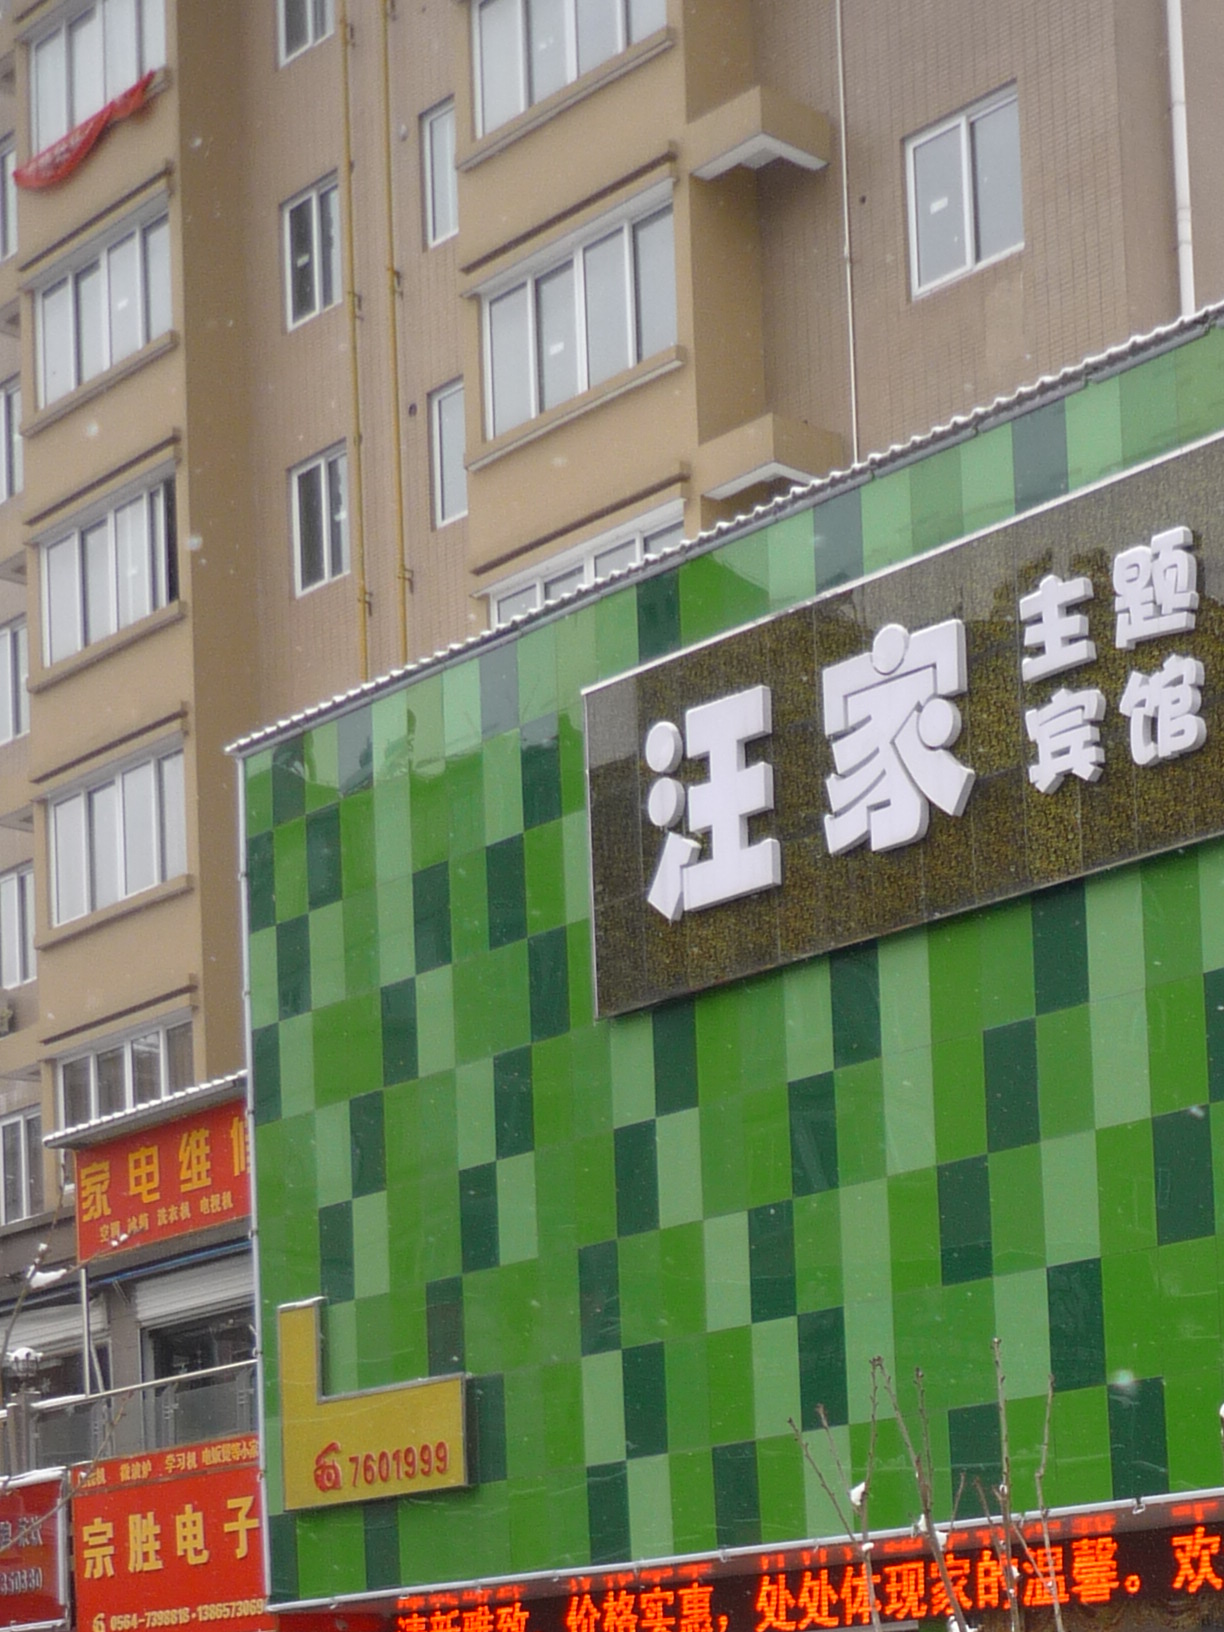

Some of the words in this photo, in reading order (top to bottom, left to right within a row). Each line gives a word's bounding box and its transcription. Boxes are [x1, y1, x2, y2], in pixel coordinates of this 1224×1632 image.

[1020, 526, 1199, 682] 主题
[645, 617, 977, 923] 汪家
[1024, 653, 1206, 795] 宾馆
[348, 1441, 449, 1488] 7601999
[82, 1495, 261, 1580] 宗胜电子
